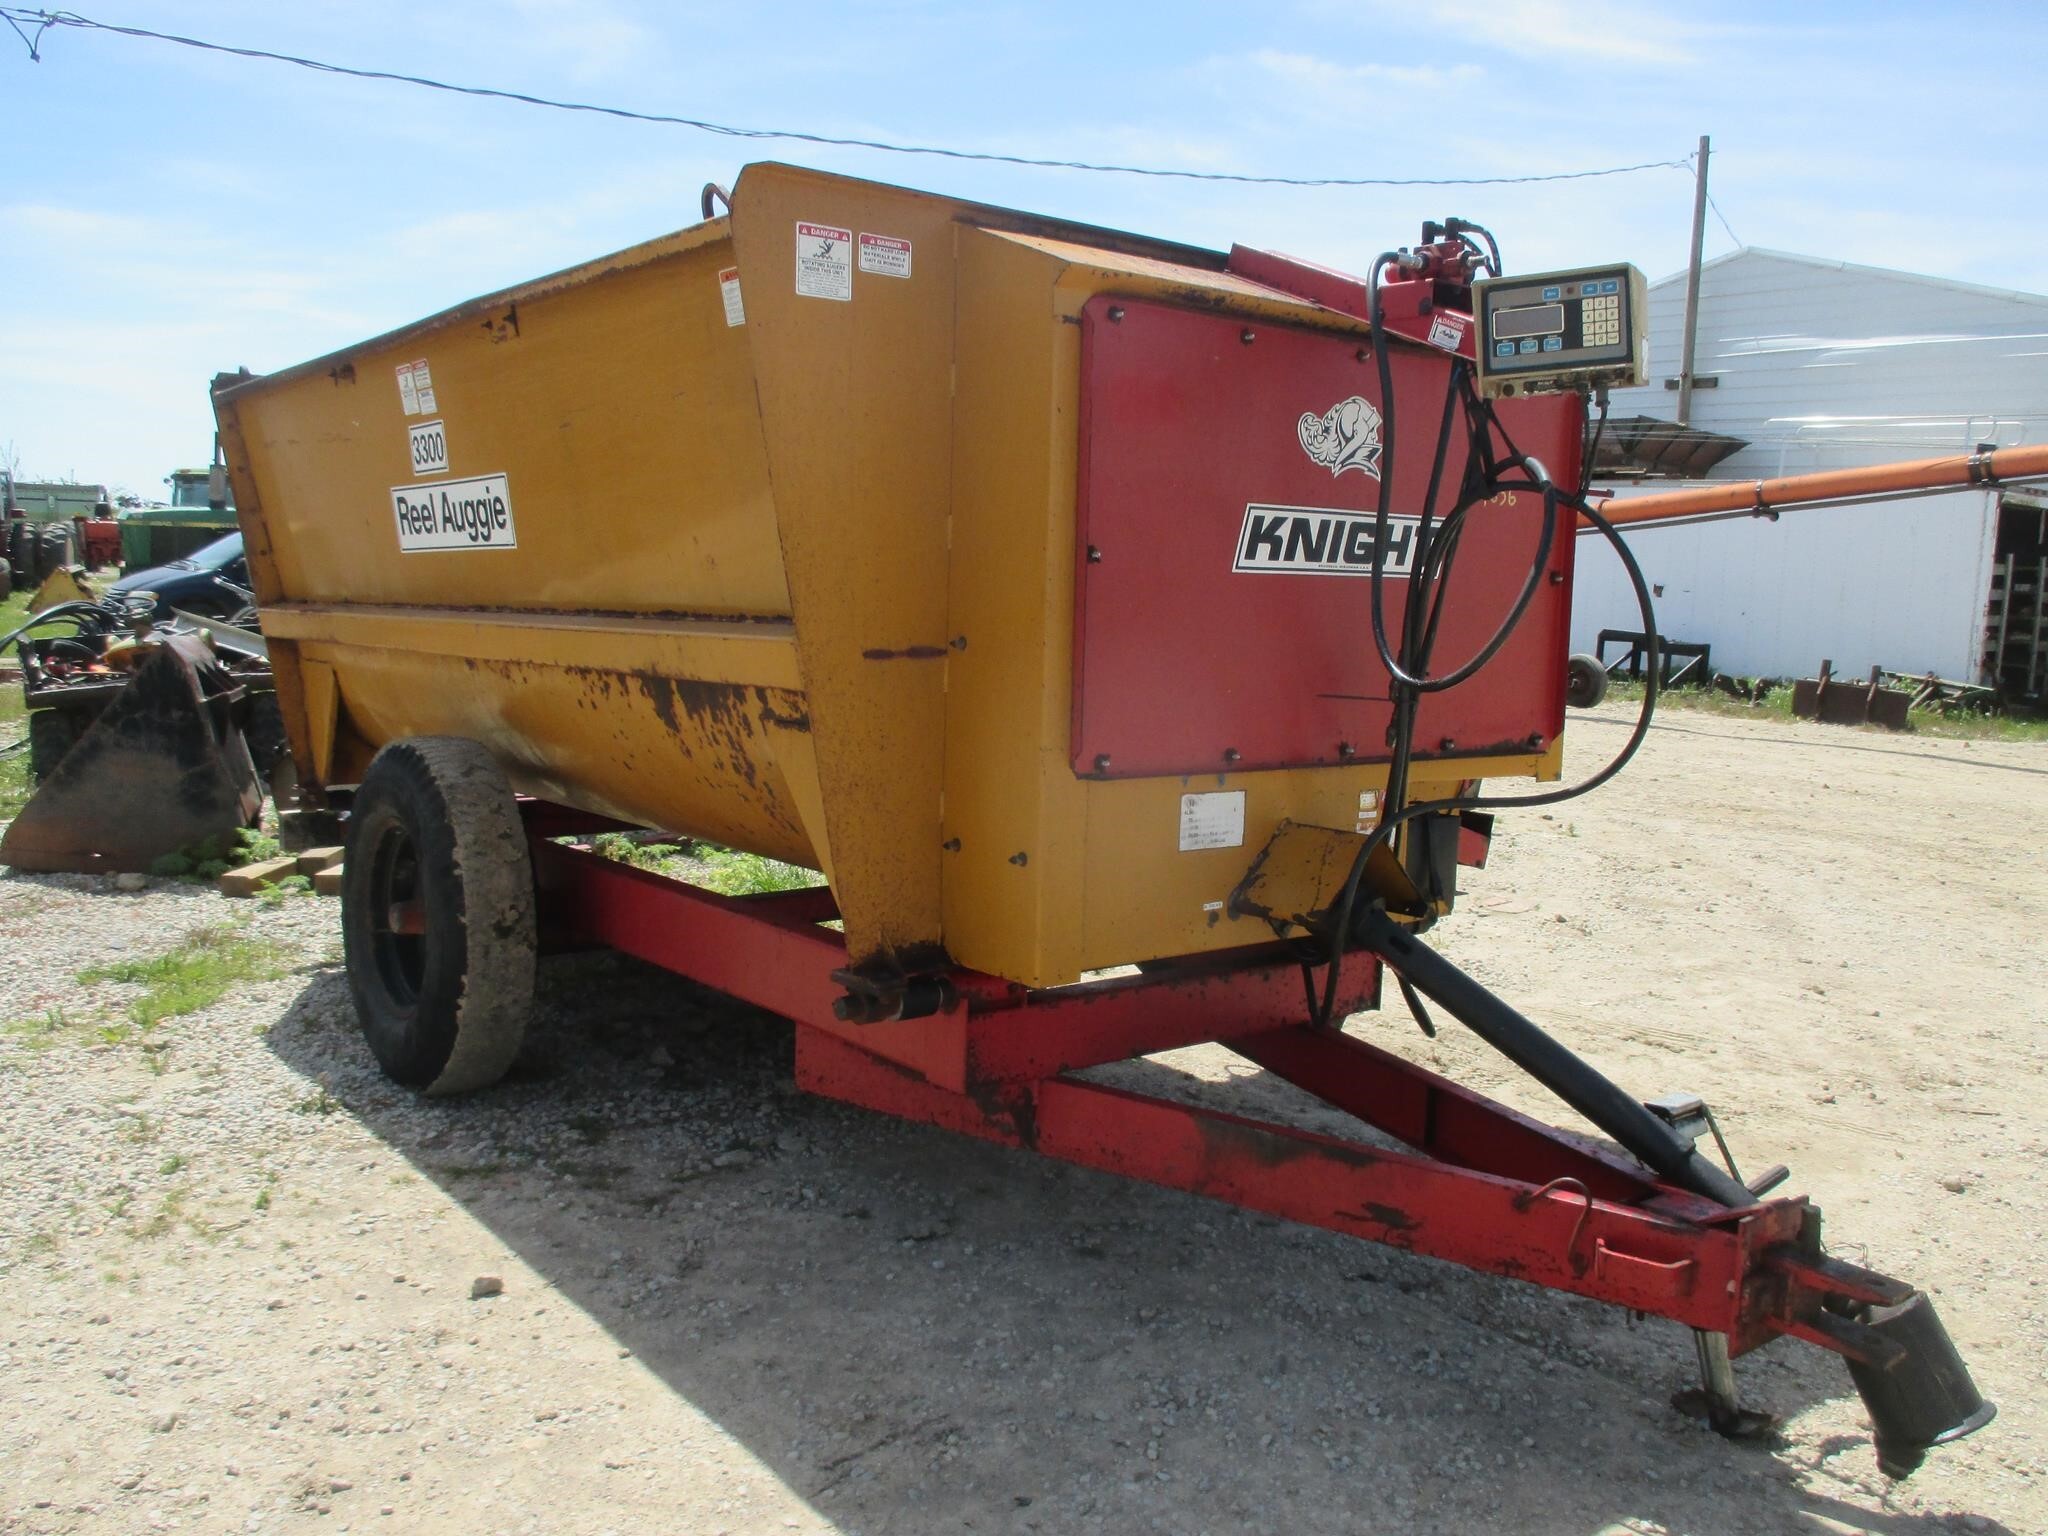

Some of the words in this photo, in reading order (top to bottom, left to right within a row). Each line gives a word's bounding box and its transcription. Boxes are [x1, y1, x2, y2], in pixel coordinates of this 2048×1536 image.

[810, 227, 839, 239] DANGER
[876, 238, 902, 249] DANGER
[412, 432, 444, 465] 3300
[396, 493, 439, 536] Reel
[442, 486, 507, 542] Auggie
